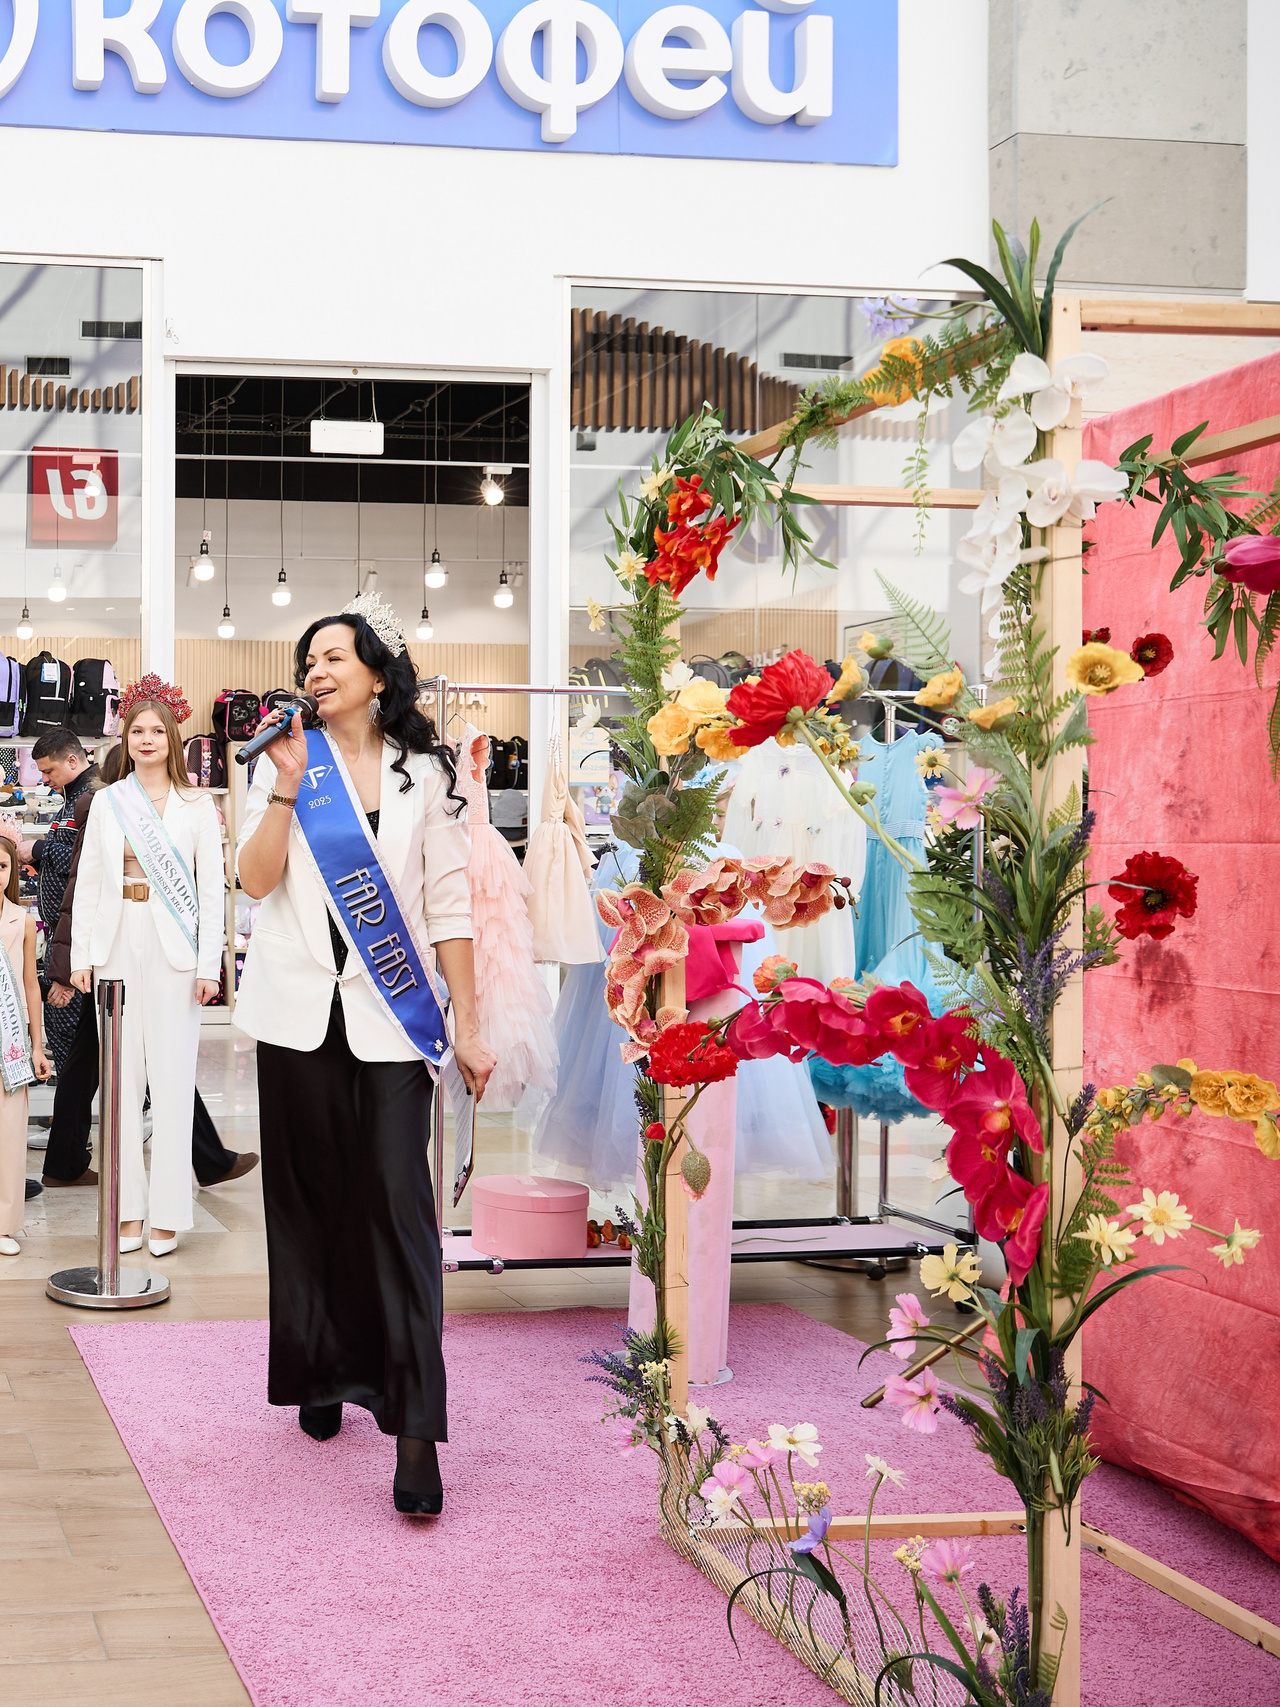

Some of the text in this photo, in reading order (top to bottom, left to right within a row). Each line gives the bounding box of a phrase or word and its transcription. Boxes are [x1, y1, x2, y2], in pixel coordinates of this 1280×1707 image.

[308, 794, 332, 809] 2025
[138, 822, 198, 918] AMBASSADOR
[143, 853, 173, 896] PRIMORSKY
[335, 867, 420, 999] FAR EAST
